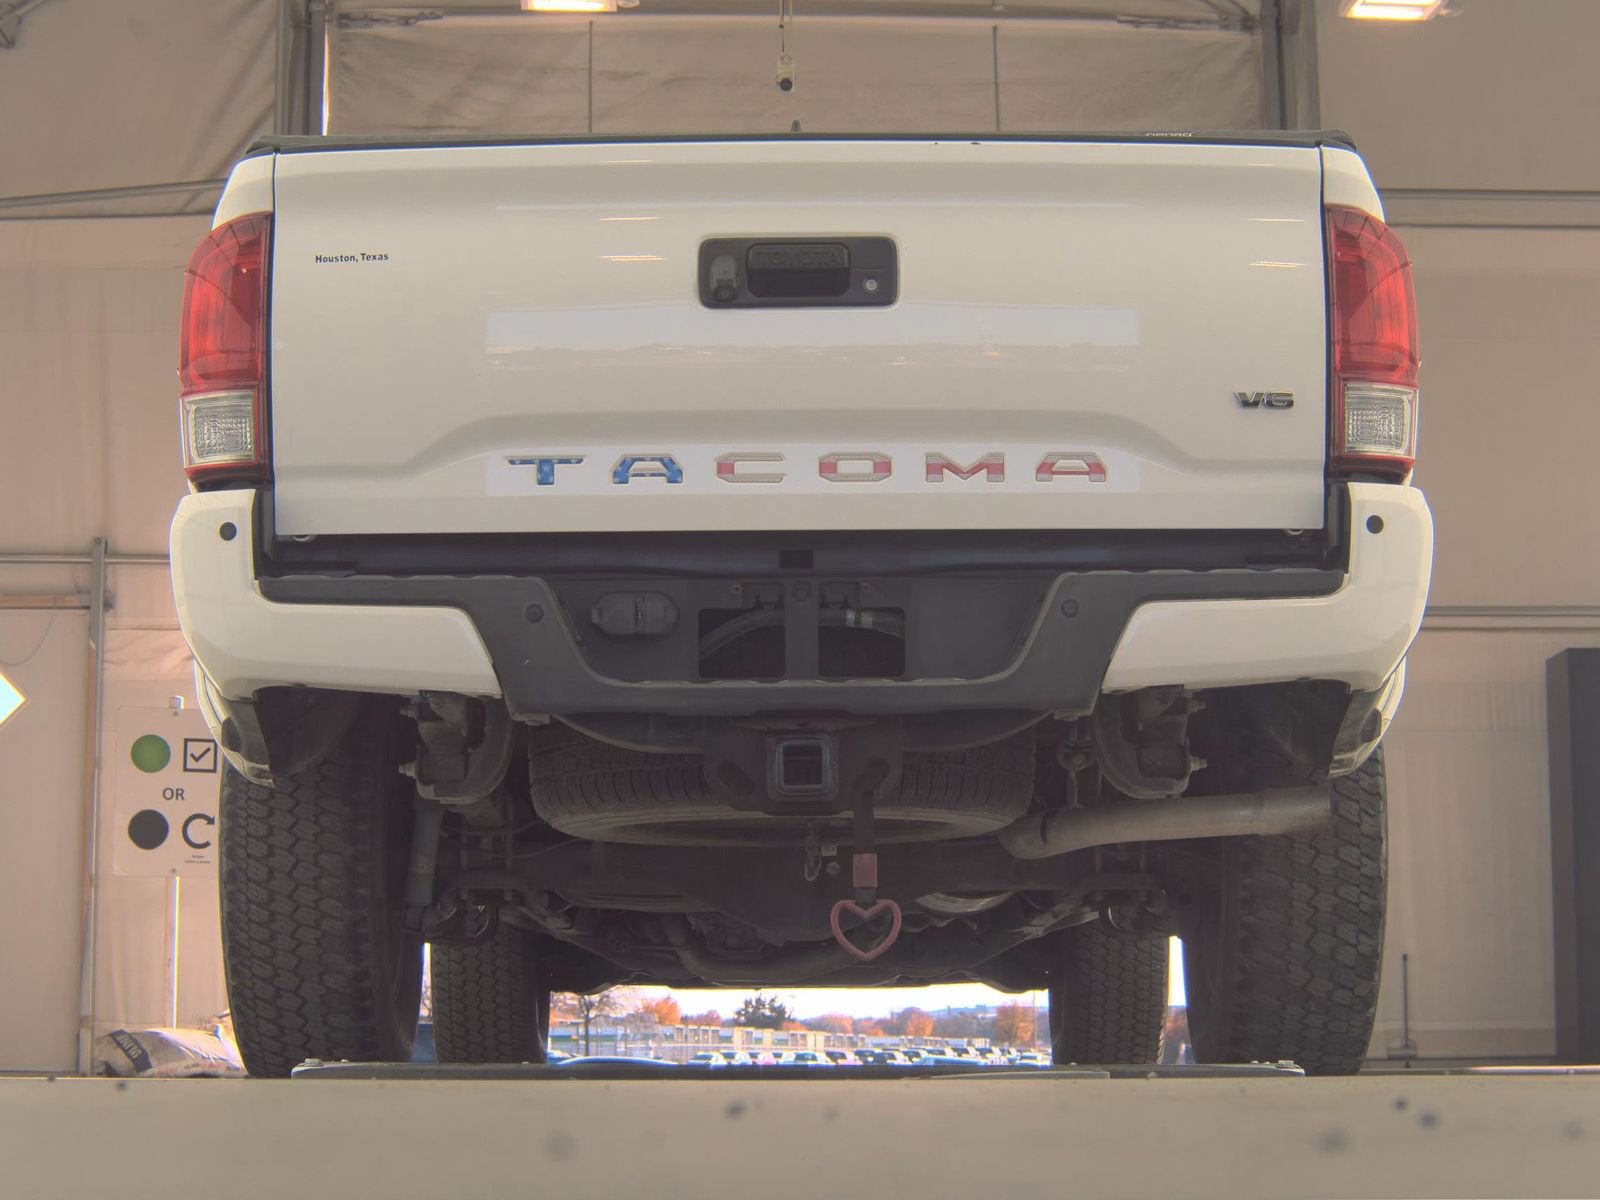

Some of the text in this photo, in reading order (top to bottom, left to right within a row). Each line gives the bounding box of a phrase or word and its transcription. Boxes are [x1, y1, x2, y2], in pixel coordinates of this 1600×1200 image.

[315, 252, 389, 264] Houston, Texas
[1234, 391, 1295, 409] V6
[503, 450, 1109, 486] TACOMA
[163, 787, 185, 801] OR
